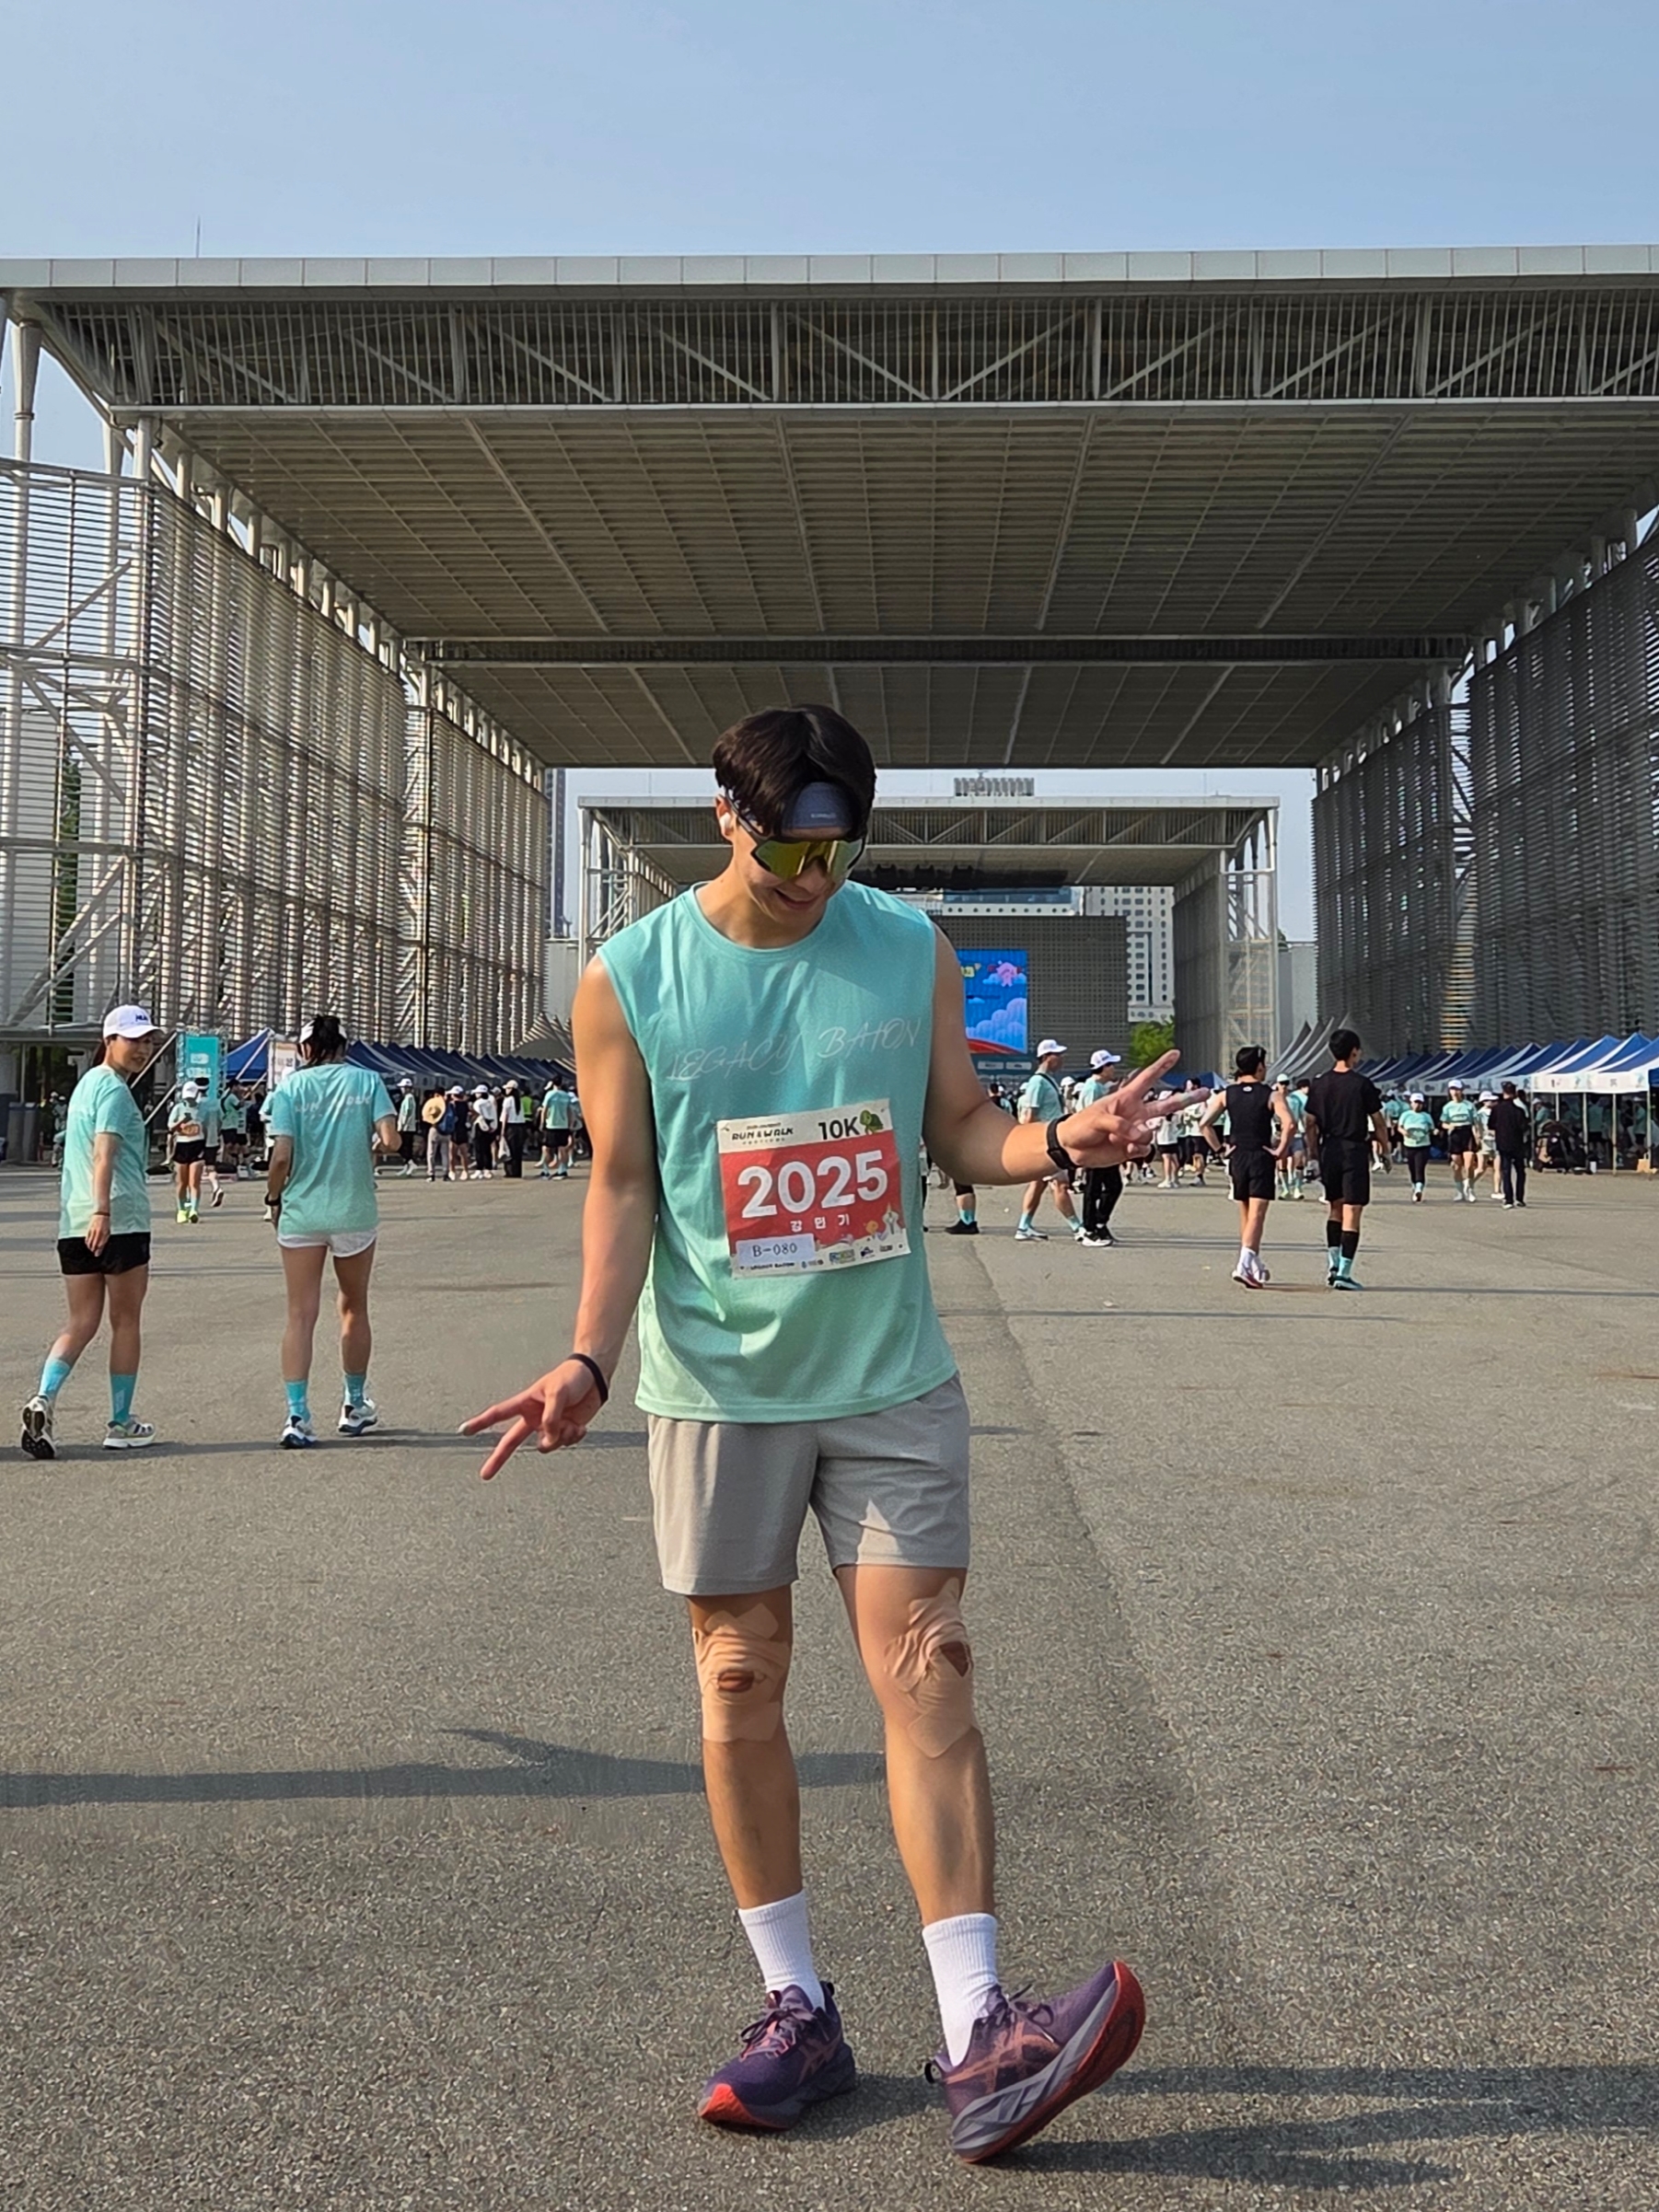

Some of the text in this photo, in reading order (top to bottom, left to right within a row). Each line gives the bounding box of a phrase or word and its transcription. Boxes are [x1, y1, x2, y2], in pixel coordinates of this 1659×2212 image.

[666, 1016, 921, 1082] LEGACY BATON
[732, 1131, 755, 1141] RUN
[763, 1128, 794, 1138] WALK
[818, 1116, 860, 1141] 10K
[737, 1150, 888, 1219] 2025
[752, 1243, 798, 1257] B-080
